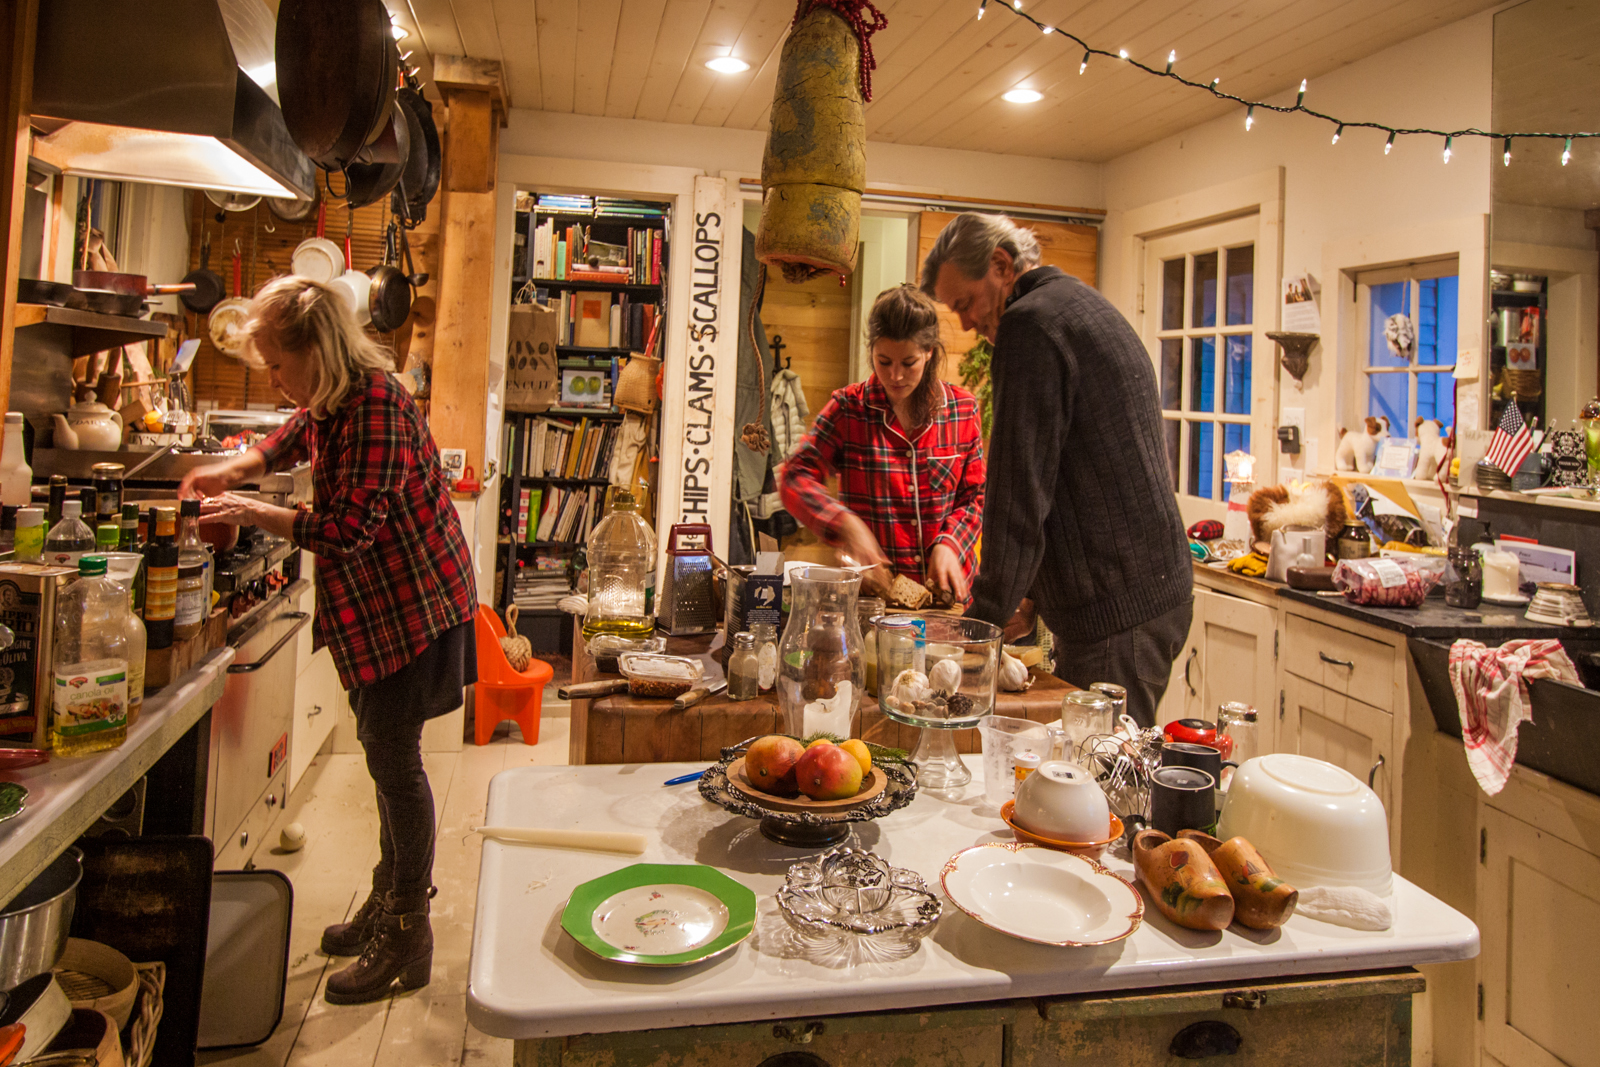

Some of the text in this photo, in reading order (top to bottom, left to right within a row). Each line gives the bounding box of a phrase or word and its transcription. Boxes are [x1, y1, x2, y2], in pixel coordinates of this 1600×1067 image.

[690, 211, 721, 343] SCALLOPS
[686, 353, 715, 447] CLAMS
[70, 685, 115, 701] canola oil
